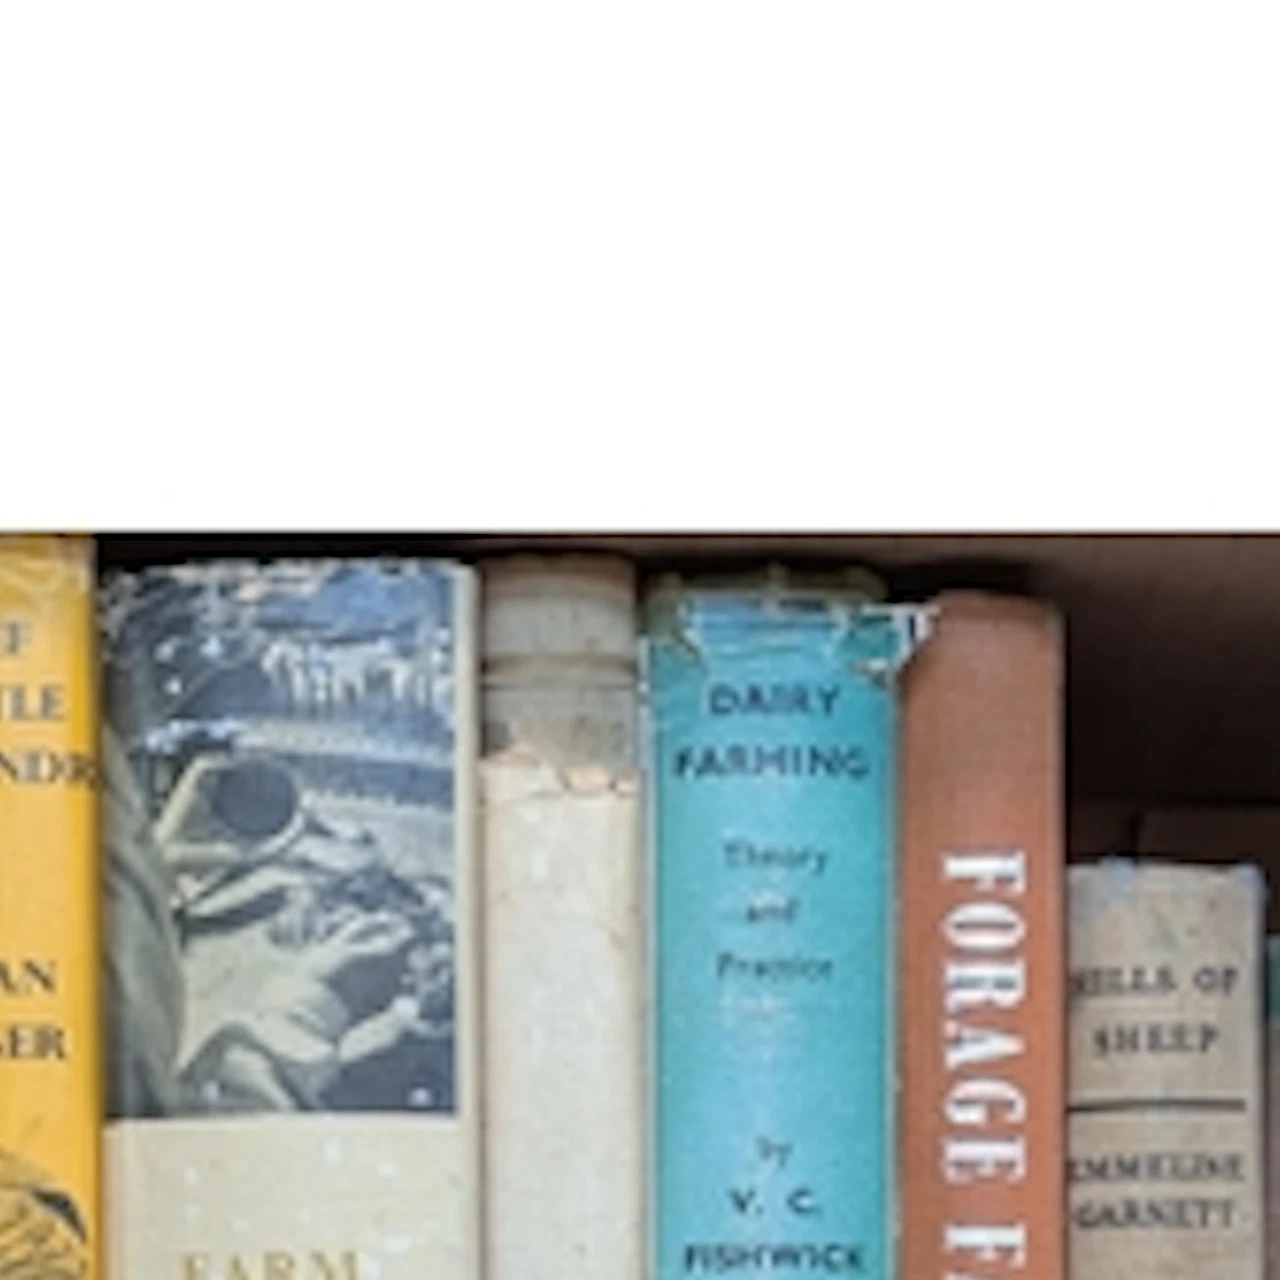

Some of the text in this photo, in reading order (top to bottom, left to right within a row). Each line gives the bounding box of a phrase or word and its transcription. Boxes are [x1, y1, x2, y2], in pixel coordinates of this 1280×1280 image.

[706, 683, 841, 717] DAIRY
[676, 744, 871, 782] FARMING
[942, 849, 1028, 1185] FORAGE
